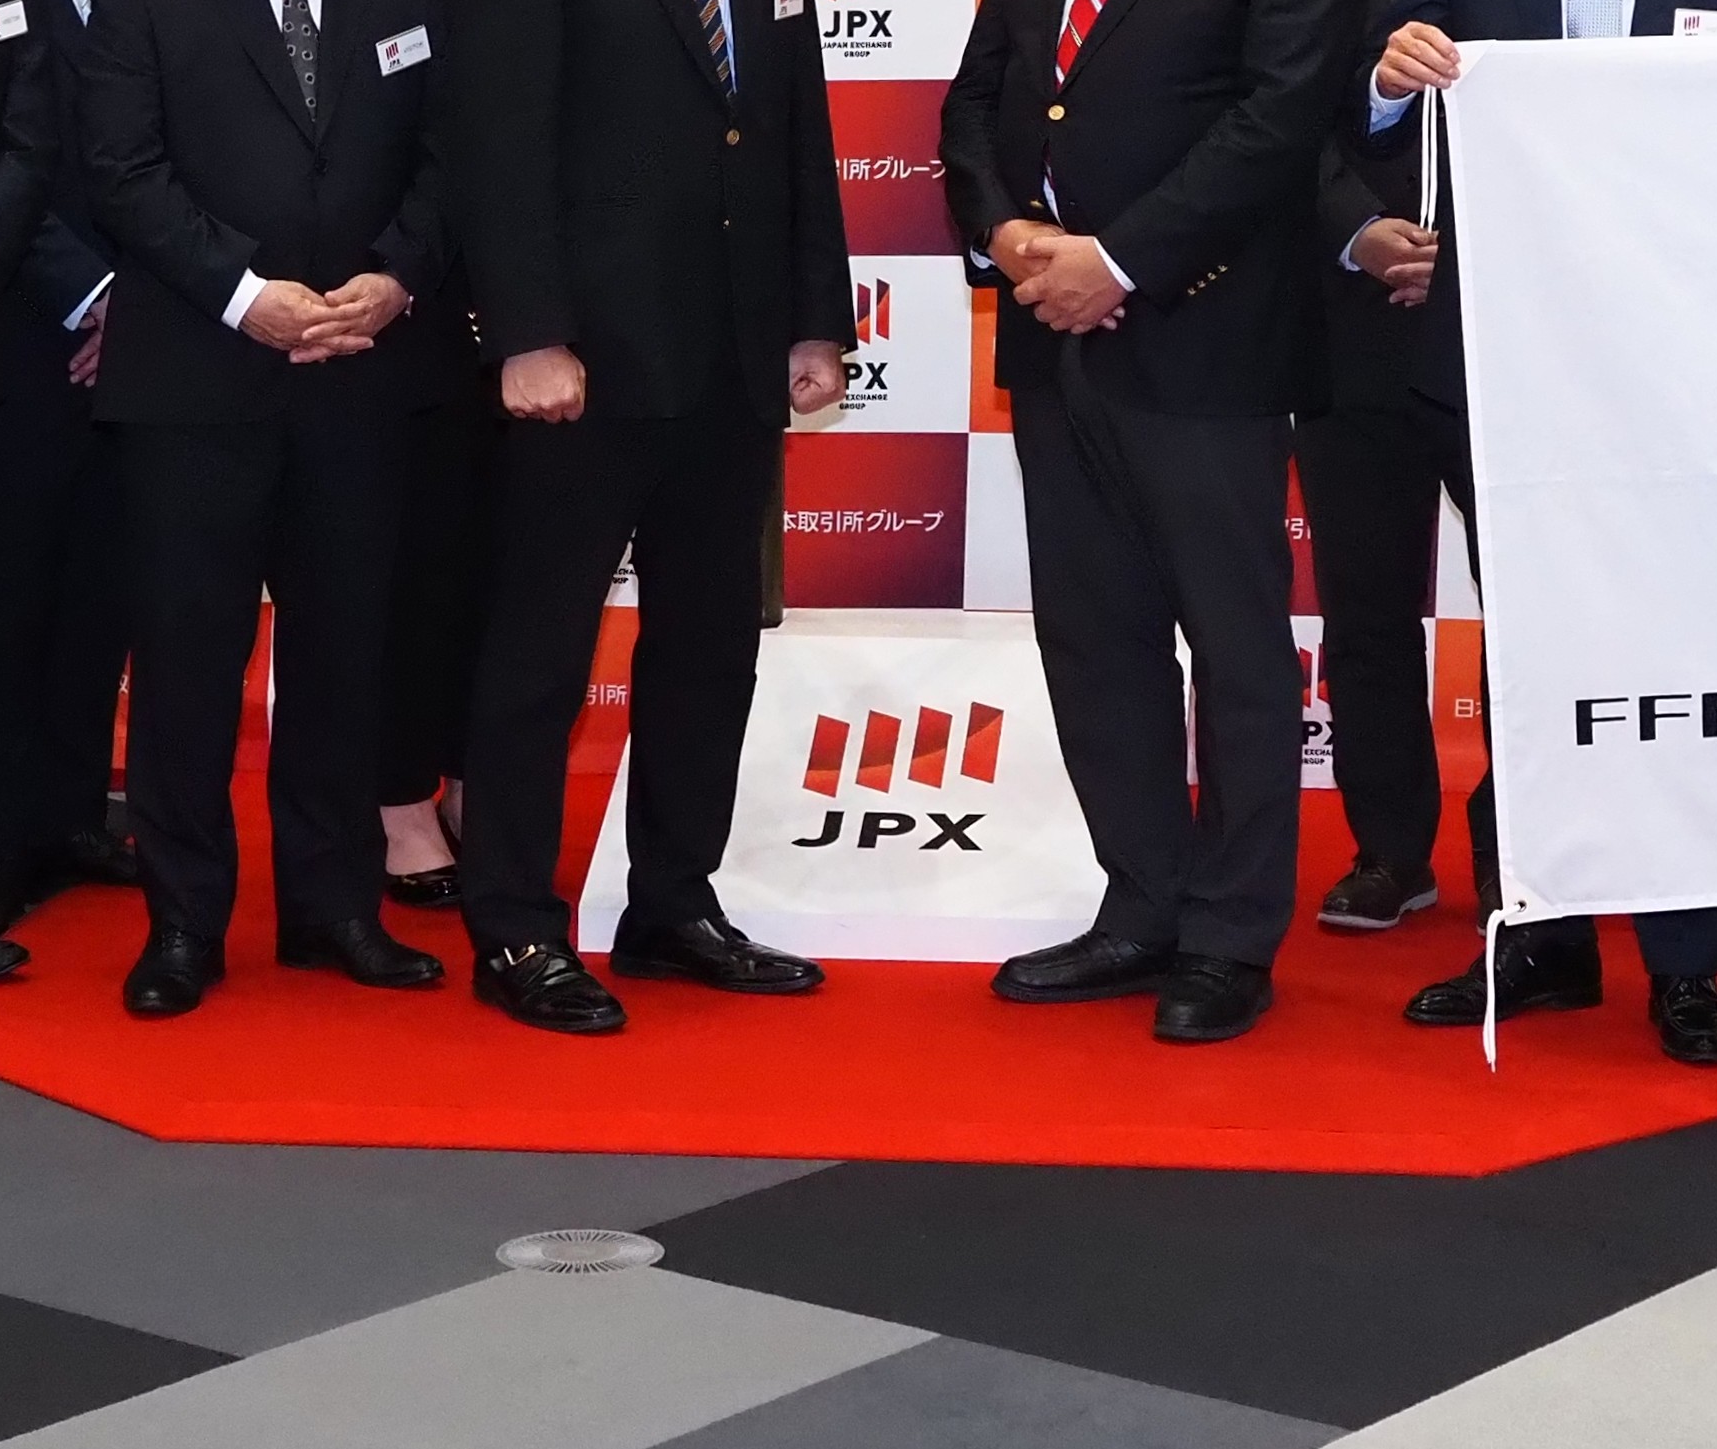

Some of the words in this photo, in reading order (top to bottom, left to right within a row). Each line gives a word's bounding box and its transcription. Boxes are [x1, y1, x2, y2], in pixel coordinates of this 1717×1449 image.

[823, 10, 893, 37] JPX
[822, 41, 848, 49] JAPAN
[850, 41, 893, 49] EXCHANGE
[844, 50, 871, 58] GROUP
[844, 363, 888, 390] PX
[783, 509, 943, 534] 本取引所グループ
[792, 810, 987, 851] JPX
